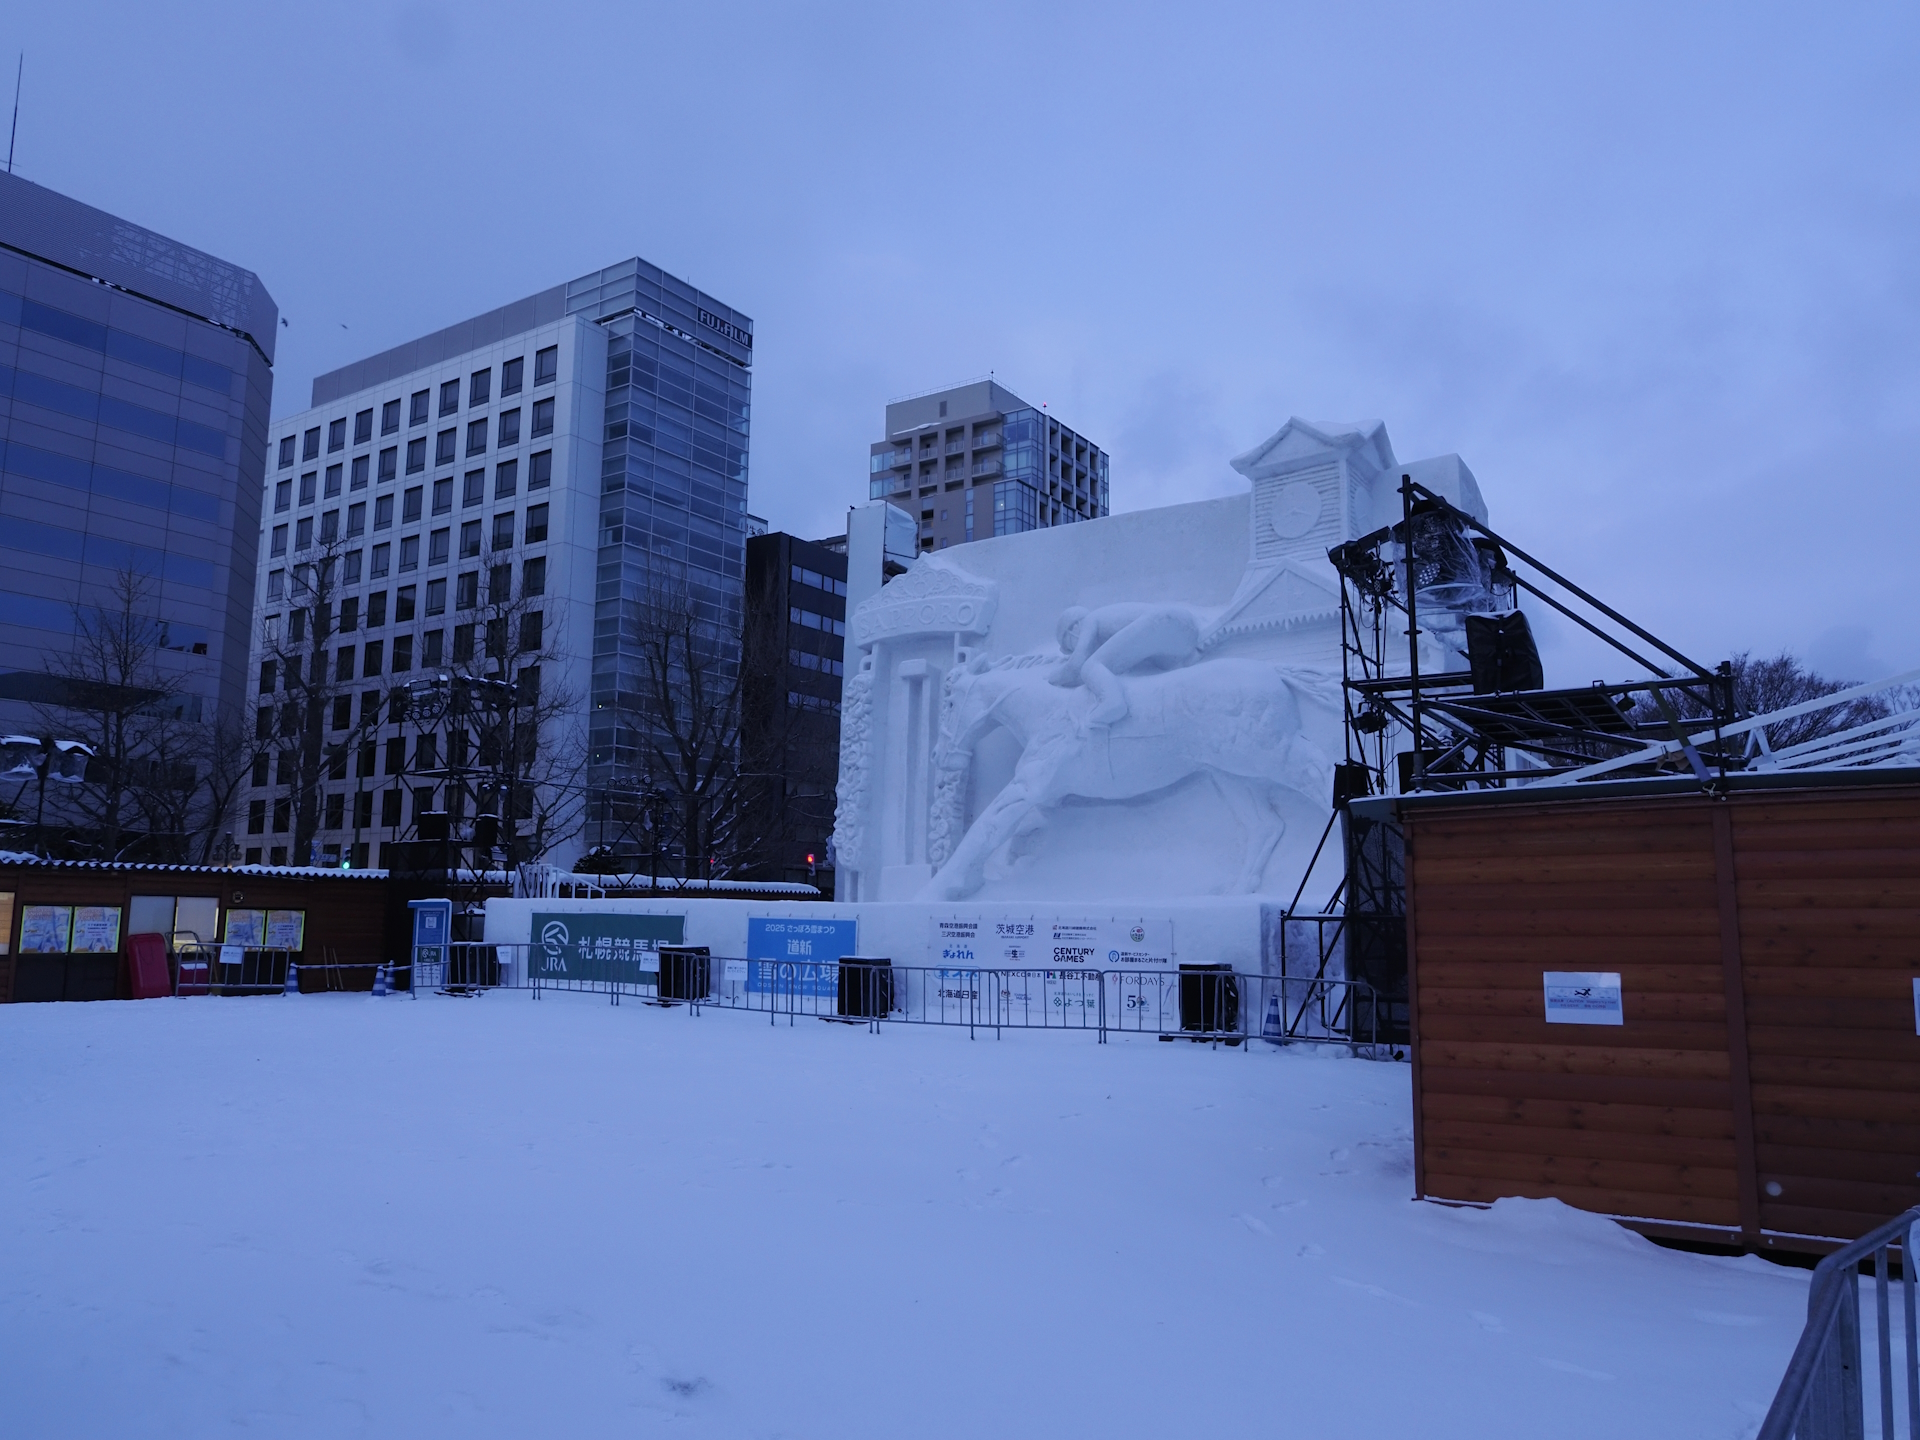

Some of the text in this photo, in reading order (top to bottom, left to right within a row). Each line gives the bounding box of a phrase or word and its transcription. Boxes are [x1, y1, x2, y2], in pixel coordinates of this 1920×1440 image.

[700, 310, 749, 346] FUJIFILM
[858, 601, 977, 639] SAPPORO
[765, 923, 836, 934] 2025 さっぽろ雪まつり
[996, 924, 1035, 935] 茨城空港
[787, 939, 812, 956] 道新
[1053, 947, 1095, 956] CENTURY
[943, 949, 974, 959] ぎょれん
[1053, 955, 1085, 963] GAMES
[540, 956, 568, 972] JRA
